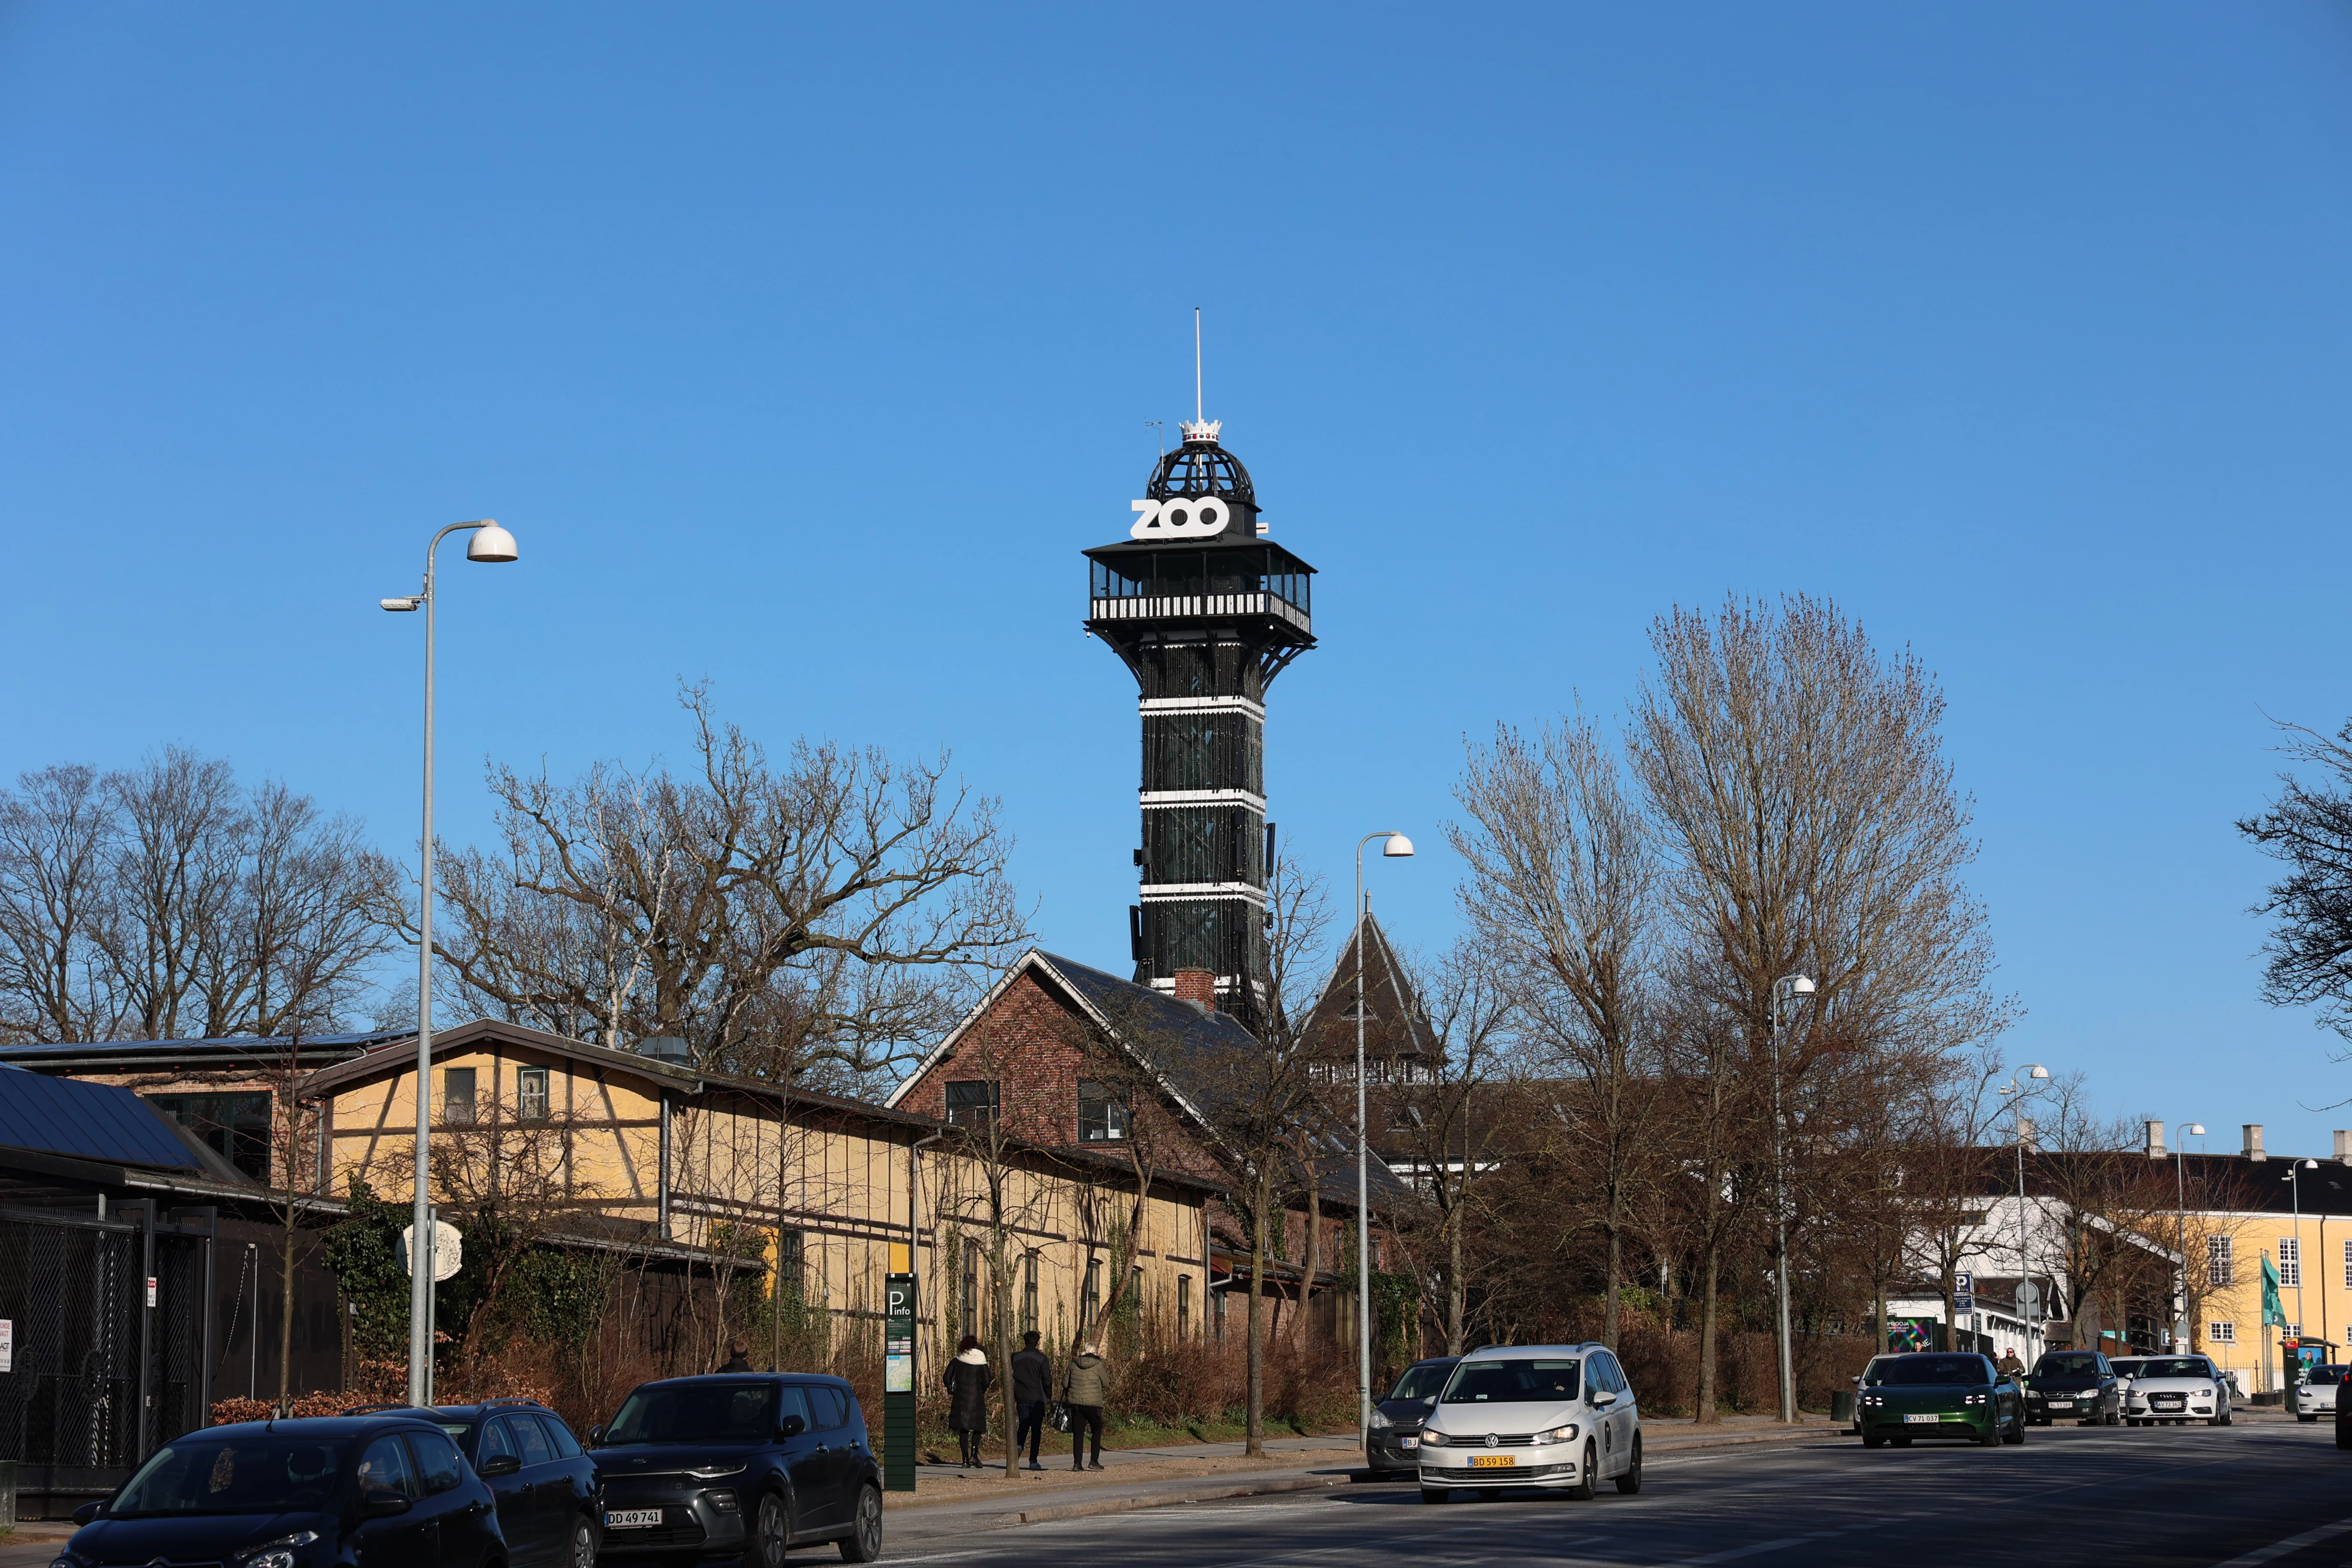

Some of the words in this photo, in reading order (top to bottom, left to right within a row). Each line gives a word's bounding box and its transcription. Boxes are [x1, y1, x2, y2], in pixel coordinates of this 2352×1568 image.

[1130, 496, 1230, 539] ZOO
[1956, 1276, 1967, 1291] P
[890, 1291, 904, 1315] P
[894, 1307, 910, 1315] info
[1473, 1458, 1485, 1466] BD
[1487, 1458, 1497, 1466] 59
[1499, 1457, 1514, 1465] 158
[609, 1513, 623, 1524] DD
[625, 1513, 638, 1523] 49
[641, 1512, 659, 1522] 741
